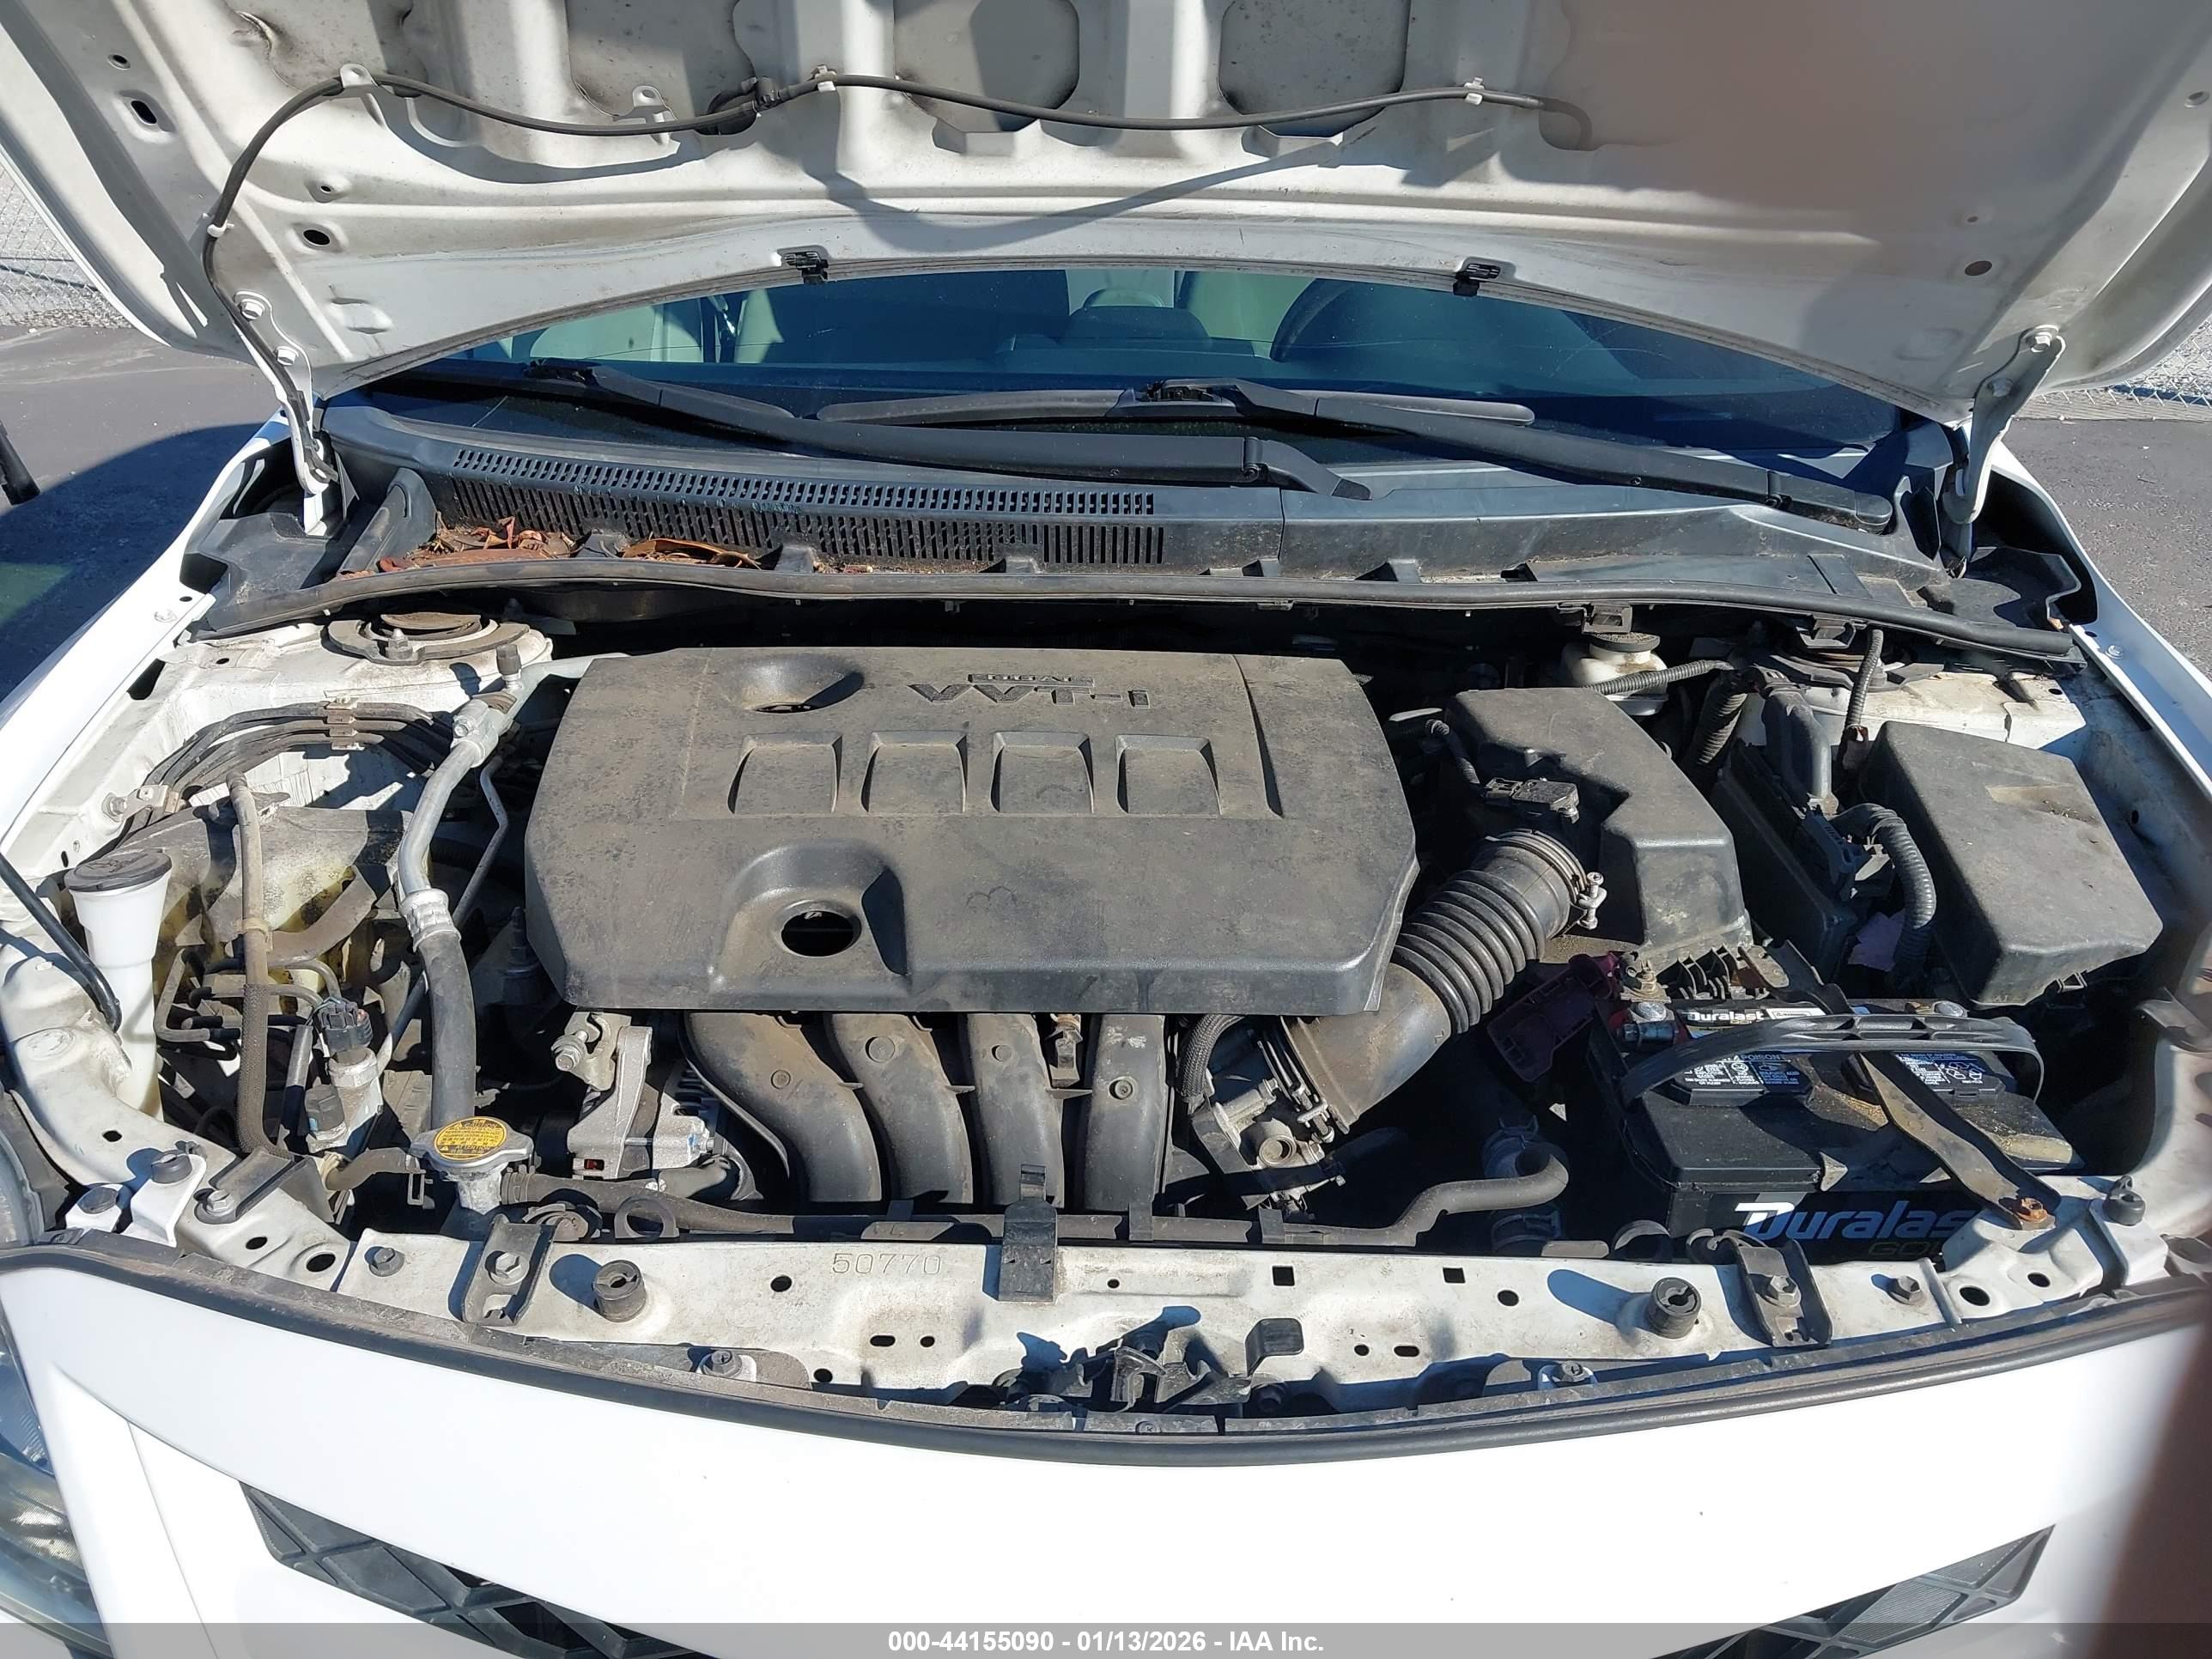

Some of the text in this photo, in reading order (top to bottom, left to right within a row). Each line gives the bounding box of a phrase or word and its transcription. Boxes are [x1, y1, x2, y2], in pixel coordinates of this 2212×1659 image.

[1681, 1011, 1765, 1022] Duralast
[1735, 1200, 1977, 1241] Duralas
[832, 1253, 942, 1275] 50770
